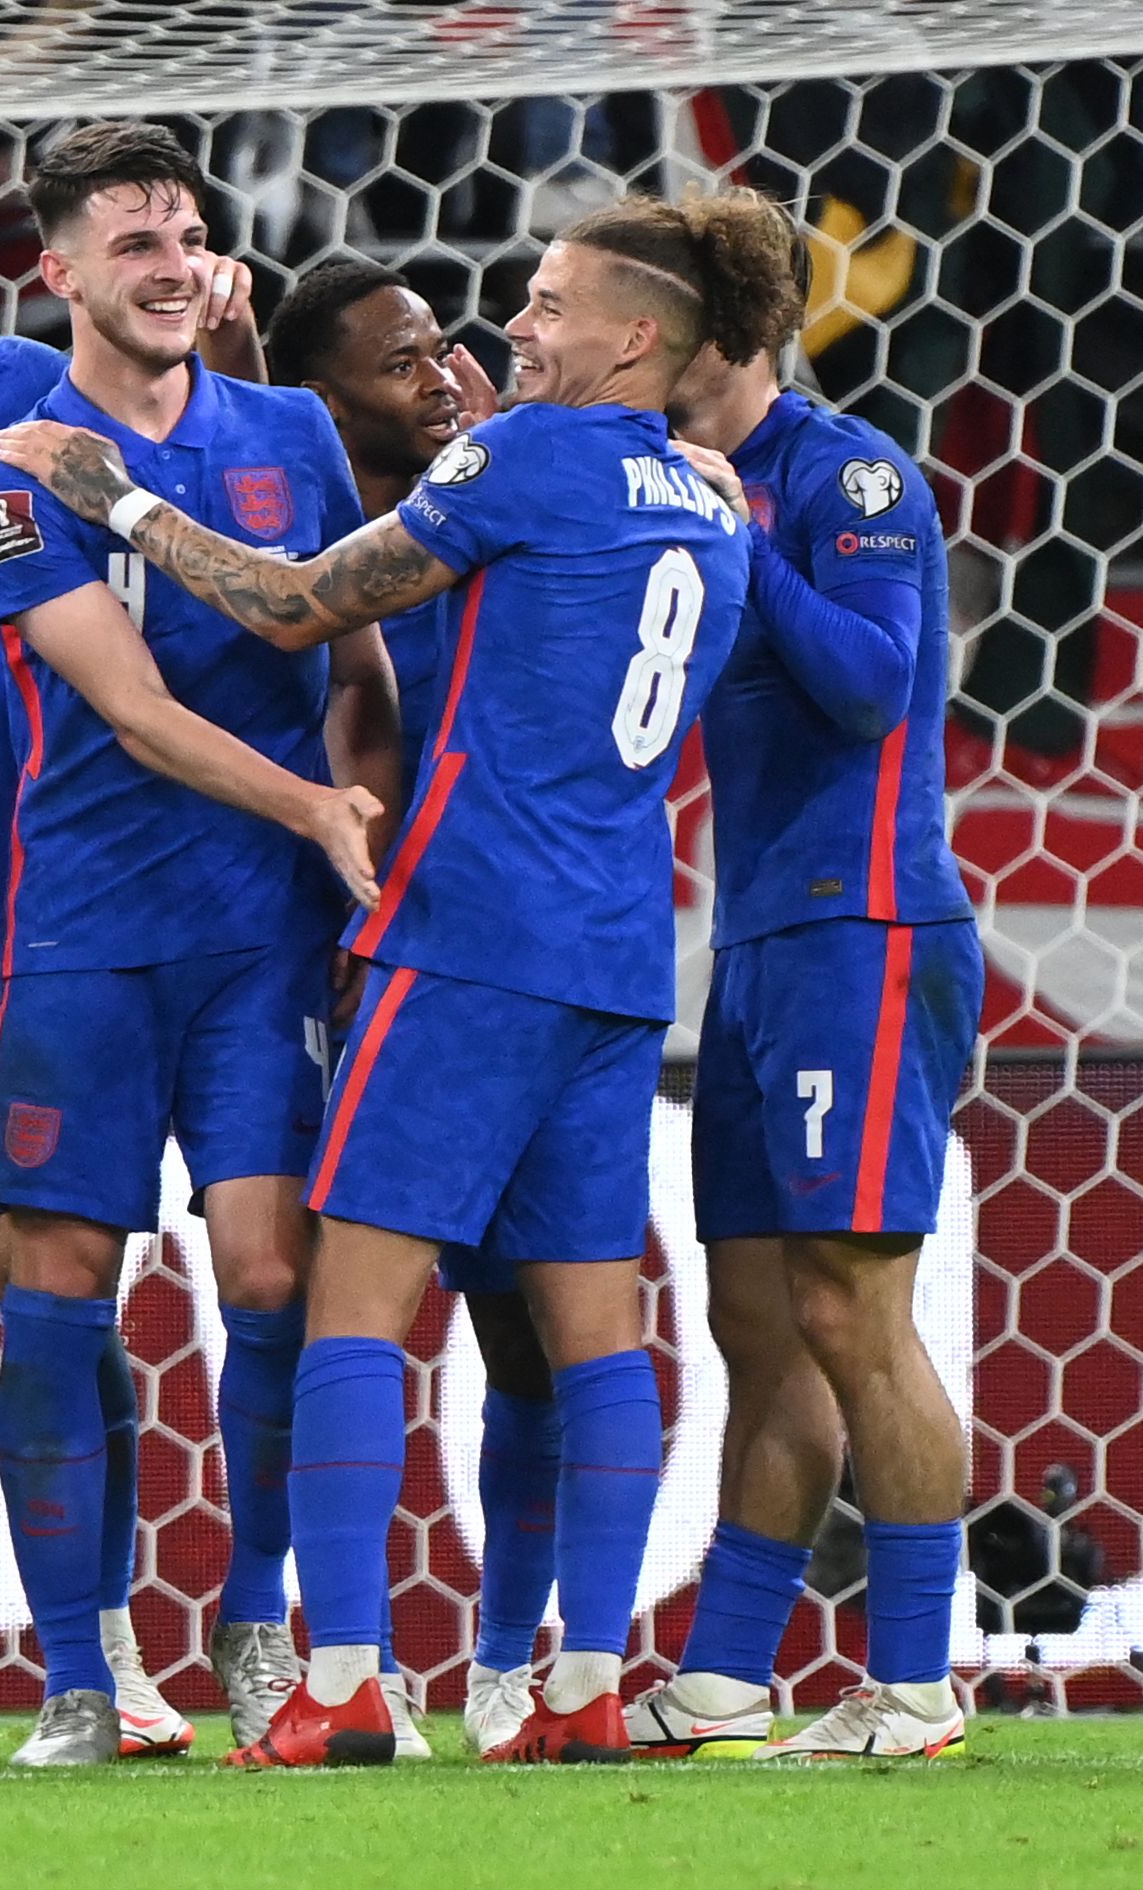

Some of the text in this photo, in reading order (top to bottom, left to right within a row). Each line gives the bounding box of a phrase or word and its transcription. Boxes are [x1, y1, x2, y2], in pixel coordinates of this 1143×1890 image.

[859, 535, 916, 551] RESPECT
[108, 552, 146, 636] 4
[611, 547, 705, 769] 8
[797, 1070, 833, 1158] 7
